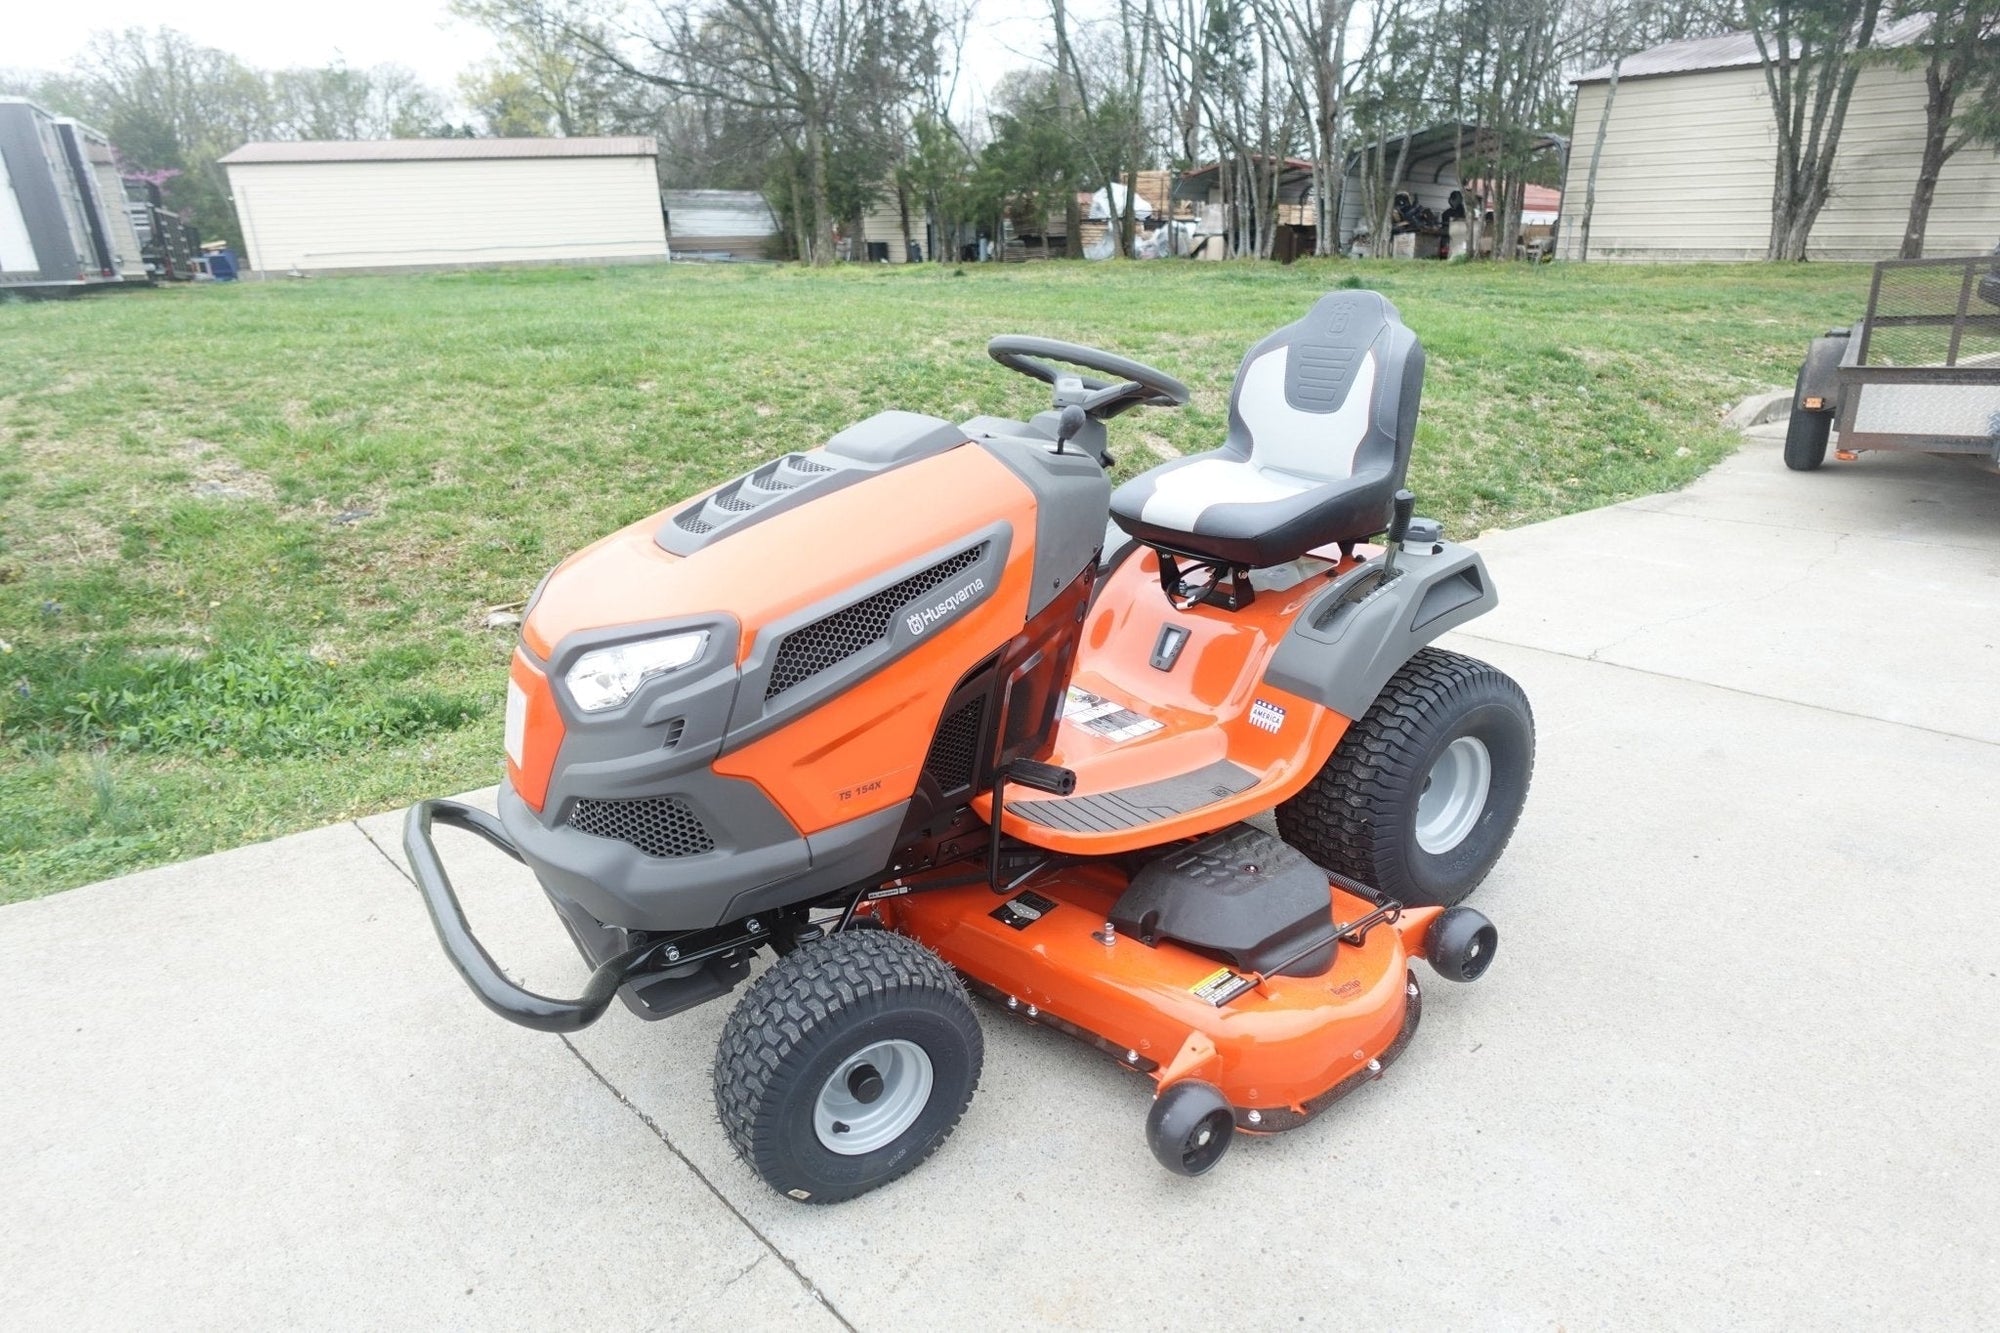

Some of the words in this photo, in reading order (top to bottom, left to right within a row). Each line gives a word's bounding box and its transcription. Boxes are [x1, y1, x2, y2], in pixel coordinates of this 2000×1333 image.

[920, 578, 984, 626] Husqvarna
[1252, 708, 1280, 723] AMERICA
[839, 790, 852, 801] TS
[856, 779, 882, 796] 154X
